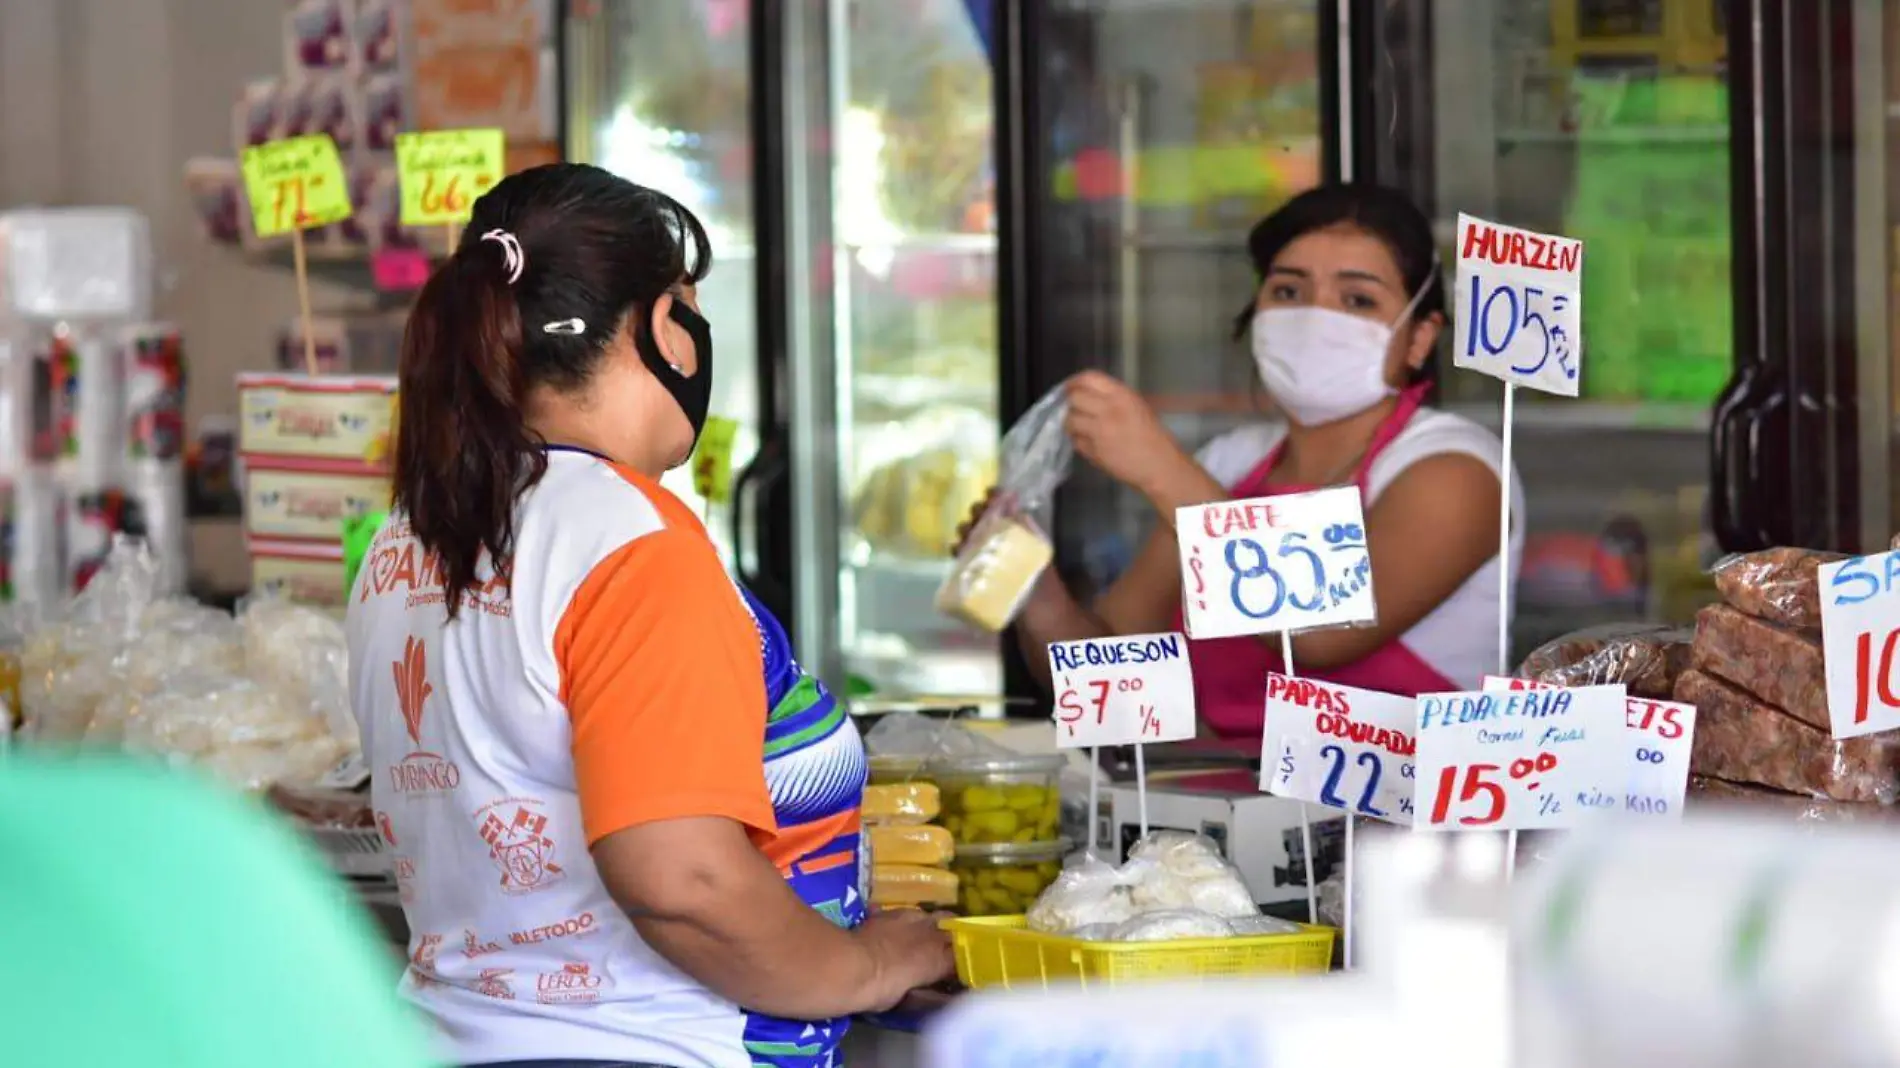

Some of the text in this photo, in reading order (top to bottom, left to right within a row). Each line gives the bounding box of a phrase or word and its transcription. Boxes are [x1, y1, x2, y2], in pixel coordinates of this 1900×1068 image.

[1462, 223, 1580, 272] HURZEN
[1467, 275, 1549, 375] 105
[1203, 503, 1290, 538] CAFE
[1224, 531, 1326, 619] 85
[1050, 634, 1180, 672] REQUESON
[1268, 676, 1351, 715] PAPAS
[1421, 690, 1573, 730] PEDACERIA
[1315, 712, 1416, 756] ODULADA
[1319, 744, 1386, 817] 22
[1430, 763, 1507, 825] 15
